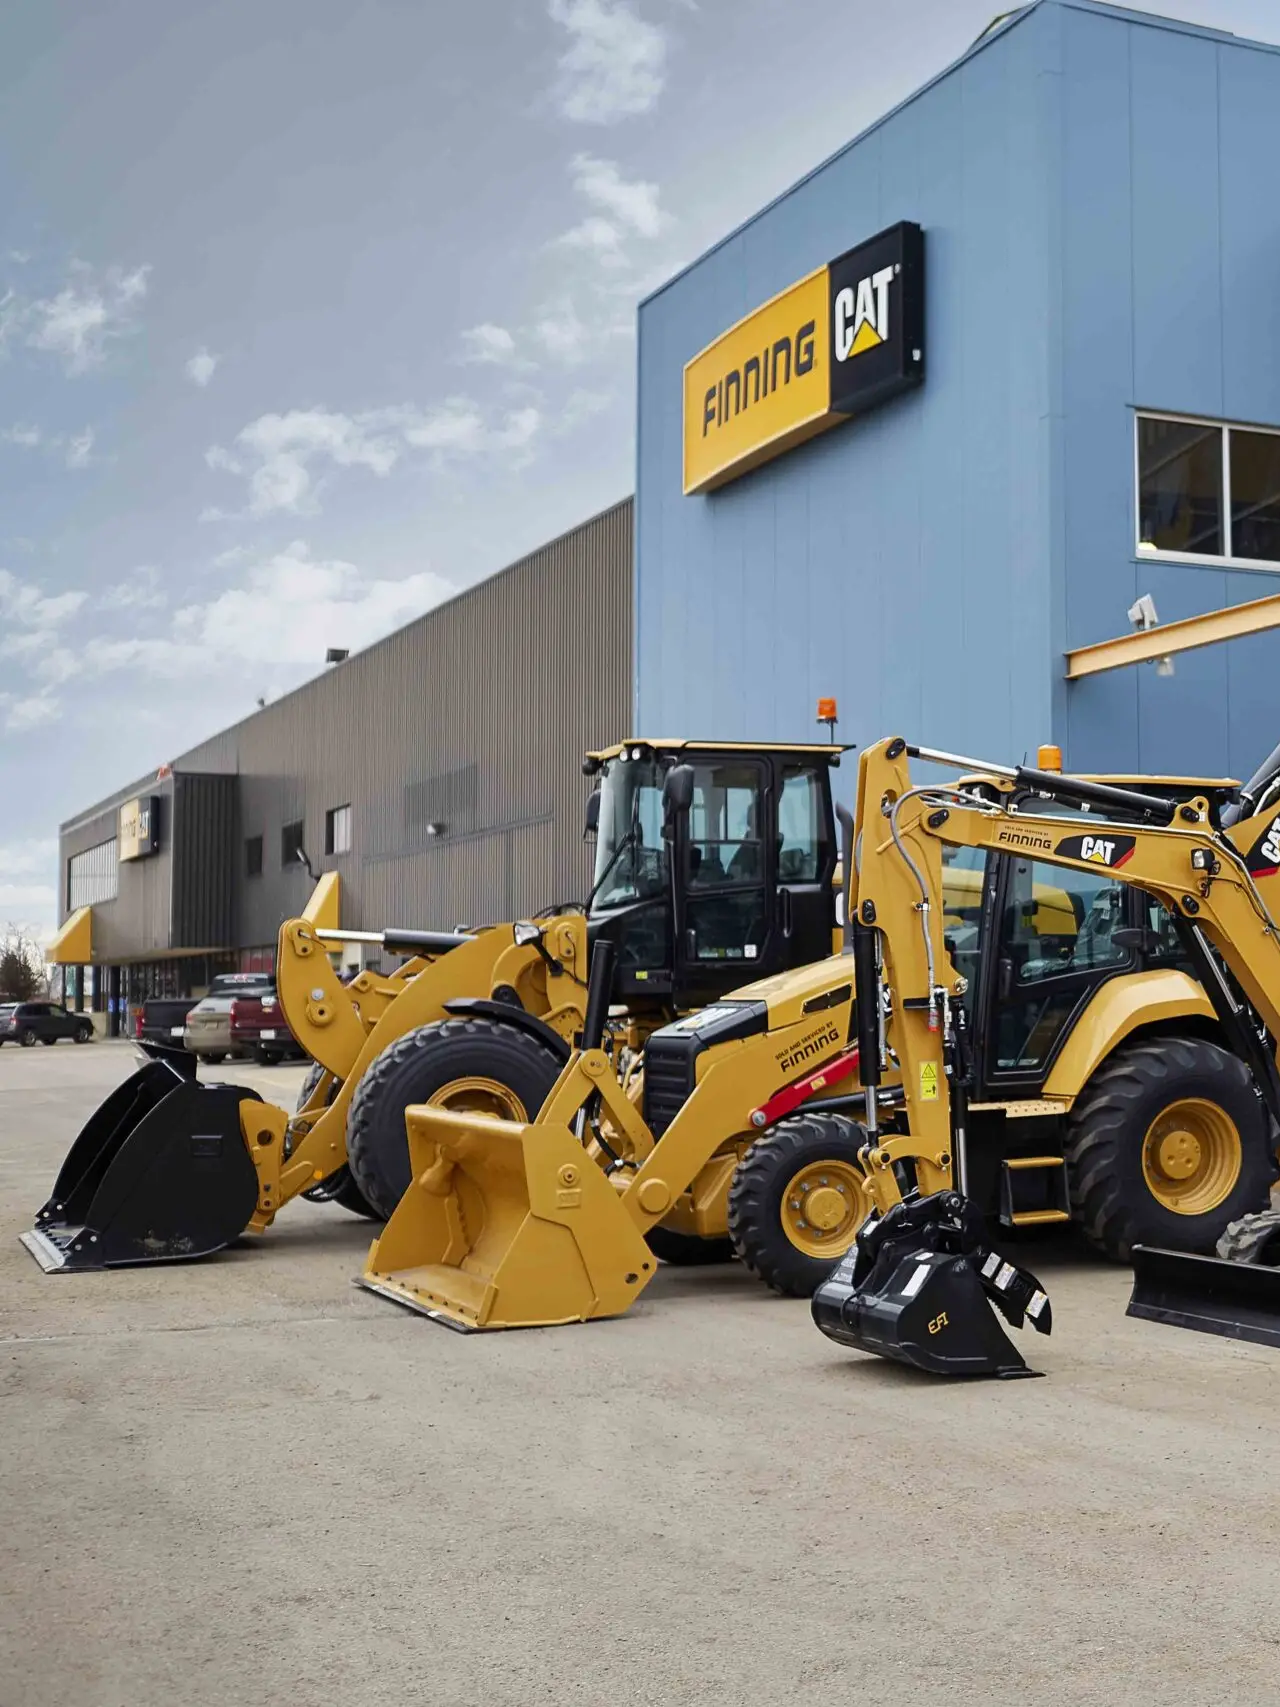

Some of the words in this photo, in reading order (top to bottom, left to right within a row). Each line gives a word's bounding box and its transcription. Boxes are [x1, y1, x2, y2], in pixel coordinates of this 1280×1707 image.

[703, 319, 816, 438] FINNING
[834, 265, 895, 363] CAT
[999, 832, 1052, 850] FINNING
[1080, 836, 1116, 865] CAT
[780, 1028, 840, 1073] FINNING
